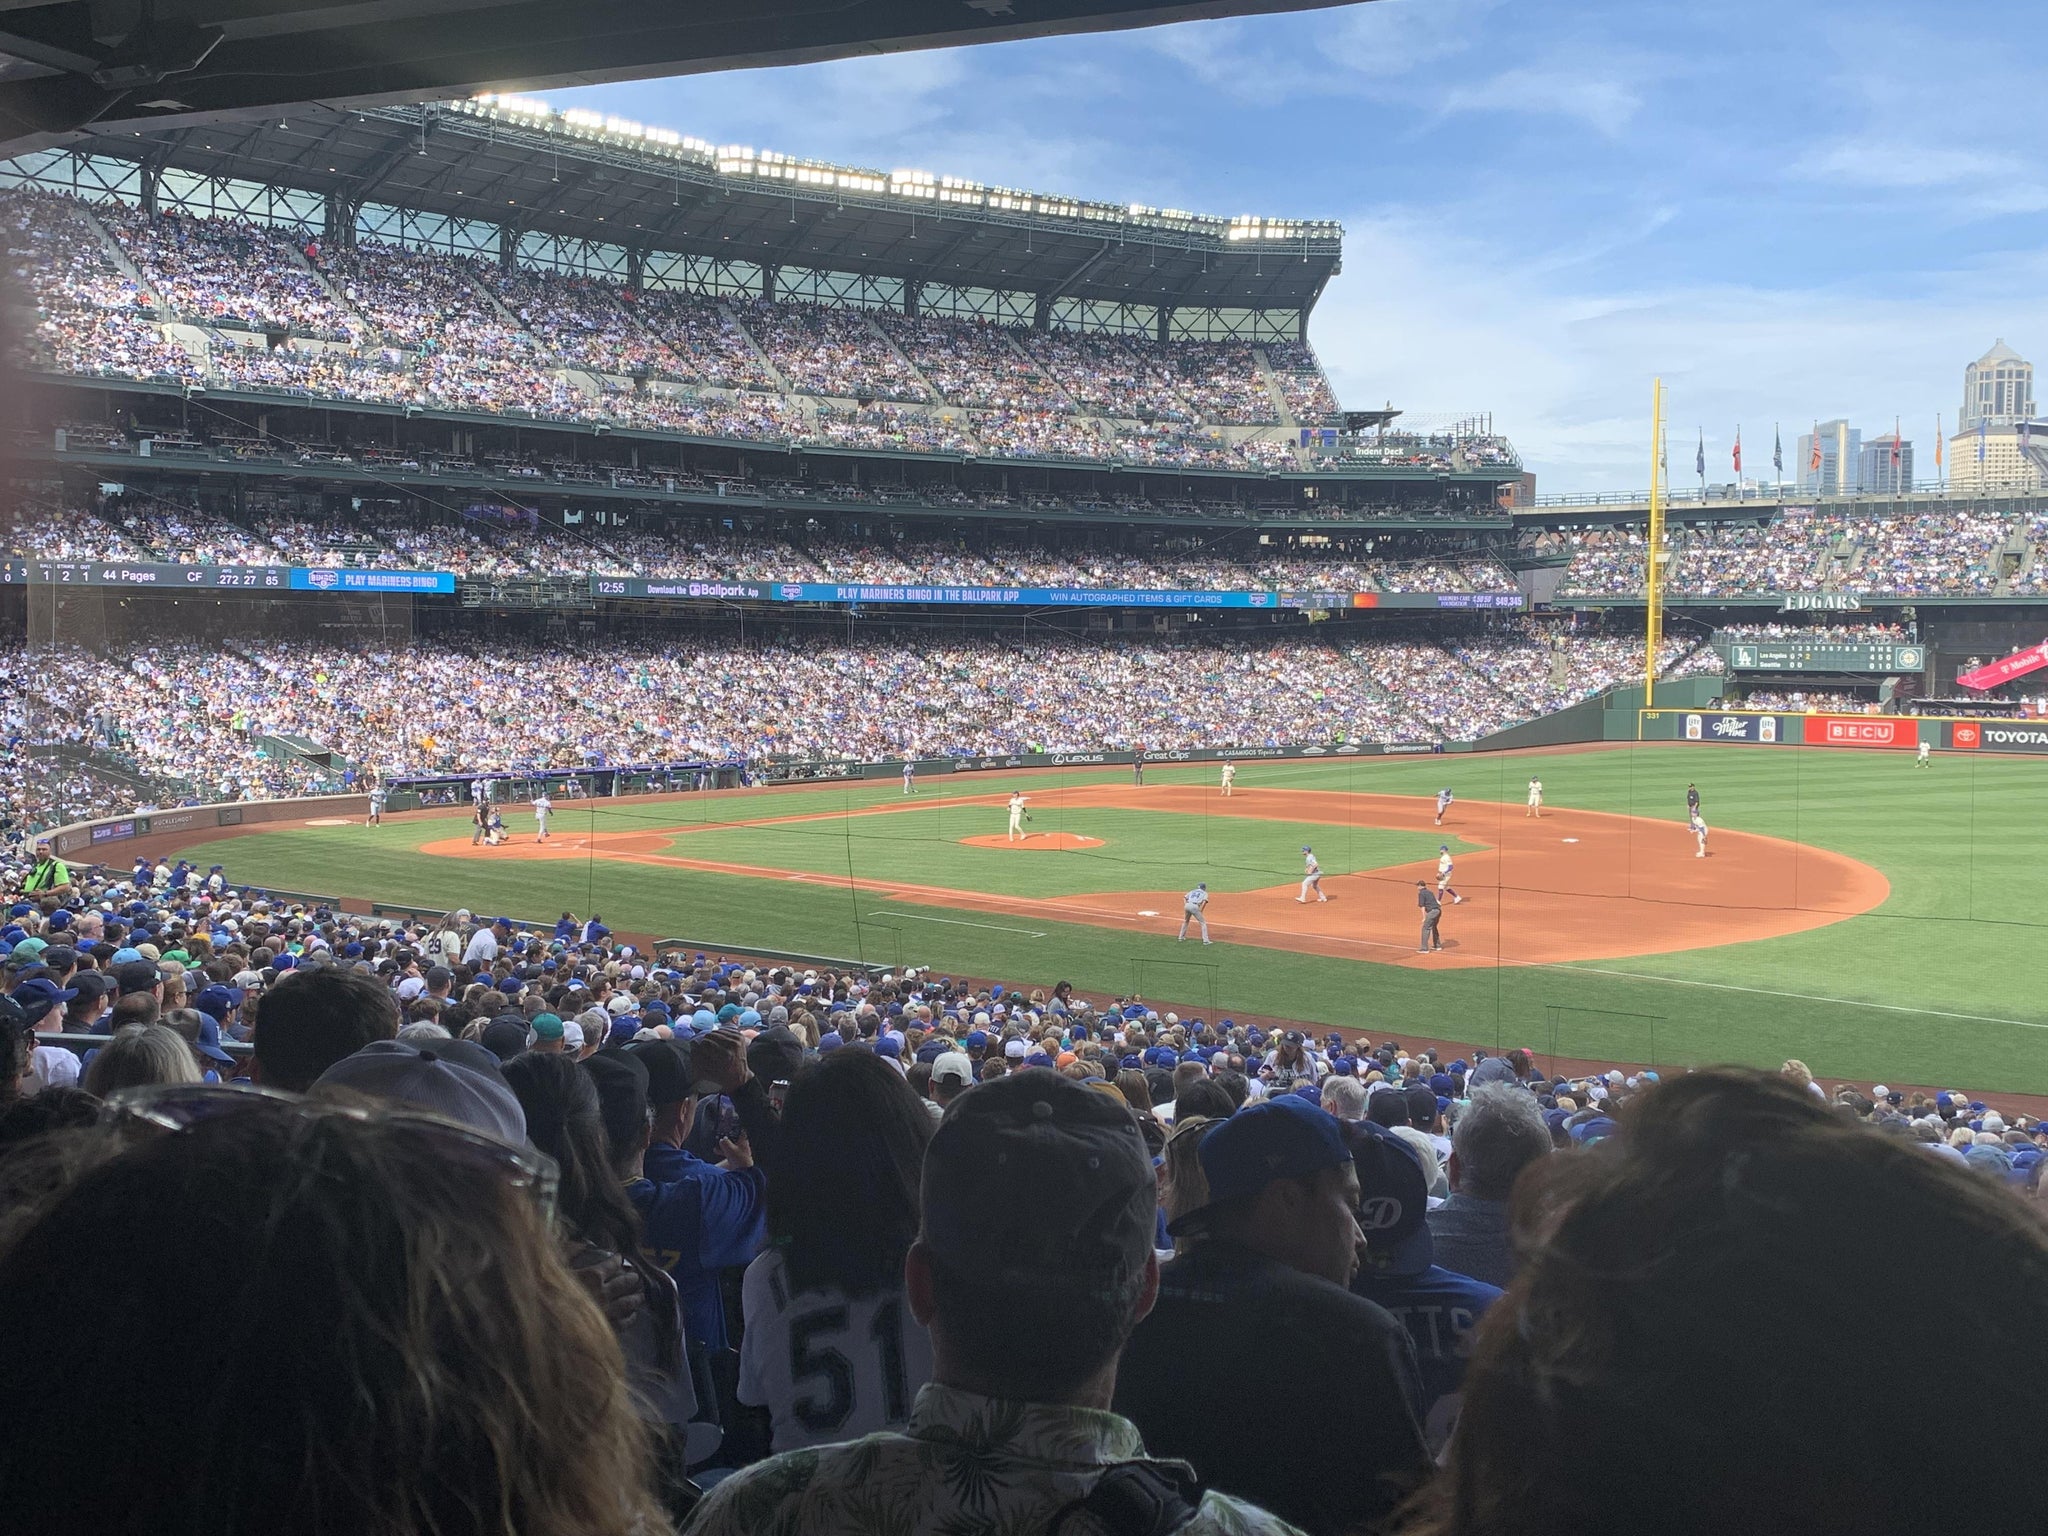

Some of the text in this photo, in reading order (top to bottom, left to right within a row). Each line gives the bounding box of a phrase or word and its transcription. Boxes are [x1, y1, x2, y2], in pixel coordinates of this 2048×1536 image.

[1354, 447, 1404, 455] Trident Deck
[4, 573, 11, 582] 0
[21, 568, 28, 577] 3
[62, 571, 70, 581] 2
[103, 570, 202, 583] 44 Pages CF
[217, 575, 278, 586] .272 27 85
[345, 574, 438, 588] PLAY MARINERS BINGO
[598, 582, 625, 594] 12:55
[647, 583, 759, 598] Download the Ballpark App
[837, 587, 1020, 602] PLAY MARINERS BINGO IN THE BALLPARK APP
[1050, 592, 1223, 604] WIN AUTOGRAPHED ITEMS & GIFT CARDS
[1496, 597, 1523, 607] $49,345
[1738, 647, 1751, 665] LA
[2010, 655, 2040, 671] Mobile
[1712, 721, 1749, 736] Miller
[1728, 729, 1747, 737] TIME
[1985, 730, 2048, 744] TOYOTA
[1065, 754, 1104, 762] LEXUS
[1143, 750, 1190, 761] Great Clips
[428, 938, 442, 954] 29
[1360, 1197, 1402, 1230] D
[1388, 1305, 1474, 1359] TTS
[790, 1301, 911, 1434] 51
